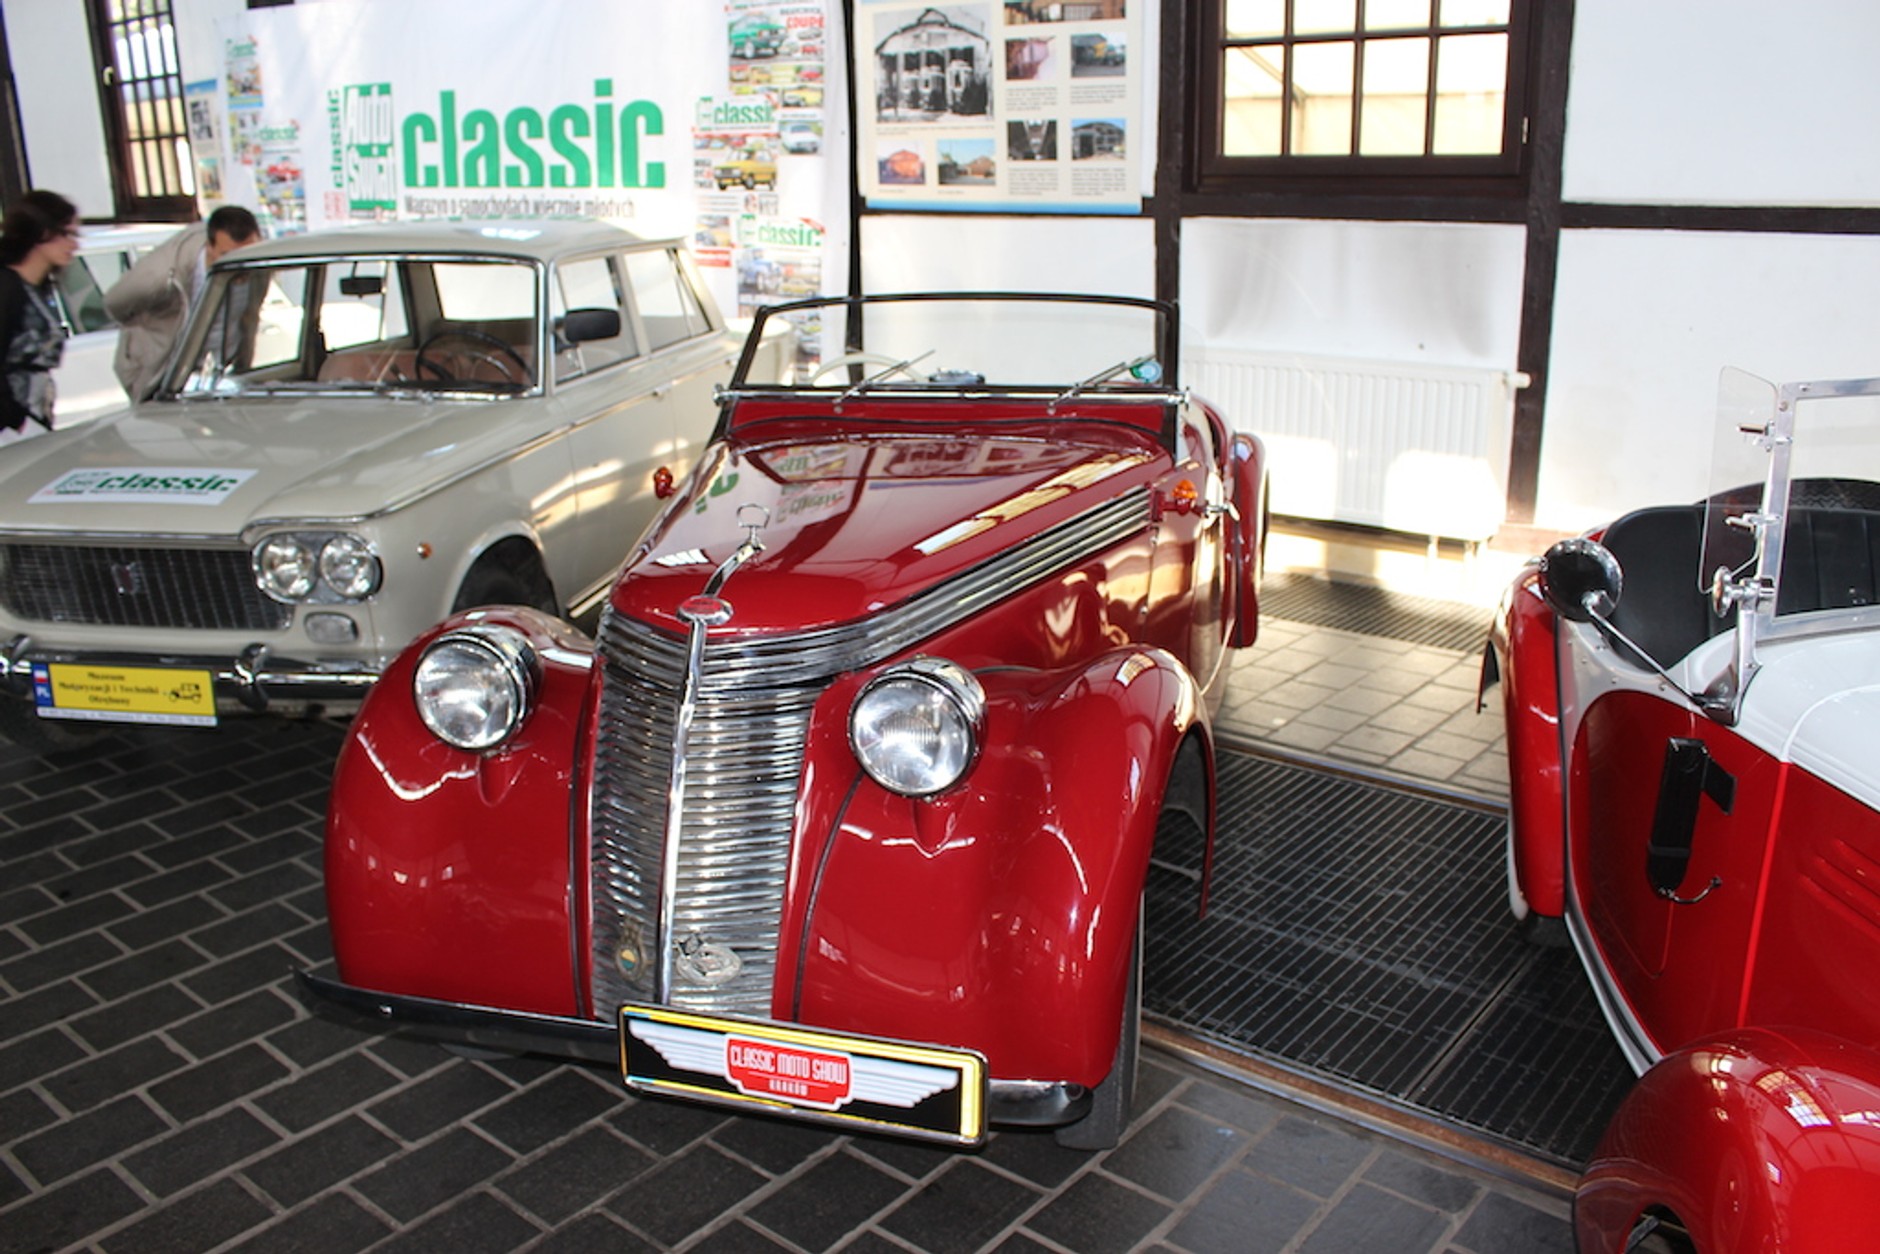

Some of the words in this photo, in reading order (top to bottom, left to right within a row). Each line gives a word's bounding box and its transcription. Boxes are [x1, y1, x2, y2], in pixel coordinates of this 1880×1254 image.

[328, 88, 344, 188] classic
[402, 78, 666, 188] classic
[96, 472, 239, 492] classic
[36, 686, 50, 699] PL
[730, 1044, 776, 1073] CLASSIC
[777, 1052, 811, 1079] MOTO
[812, 1058, 847, 1085] SHOW
